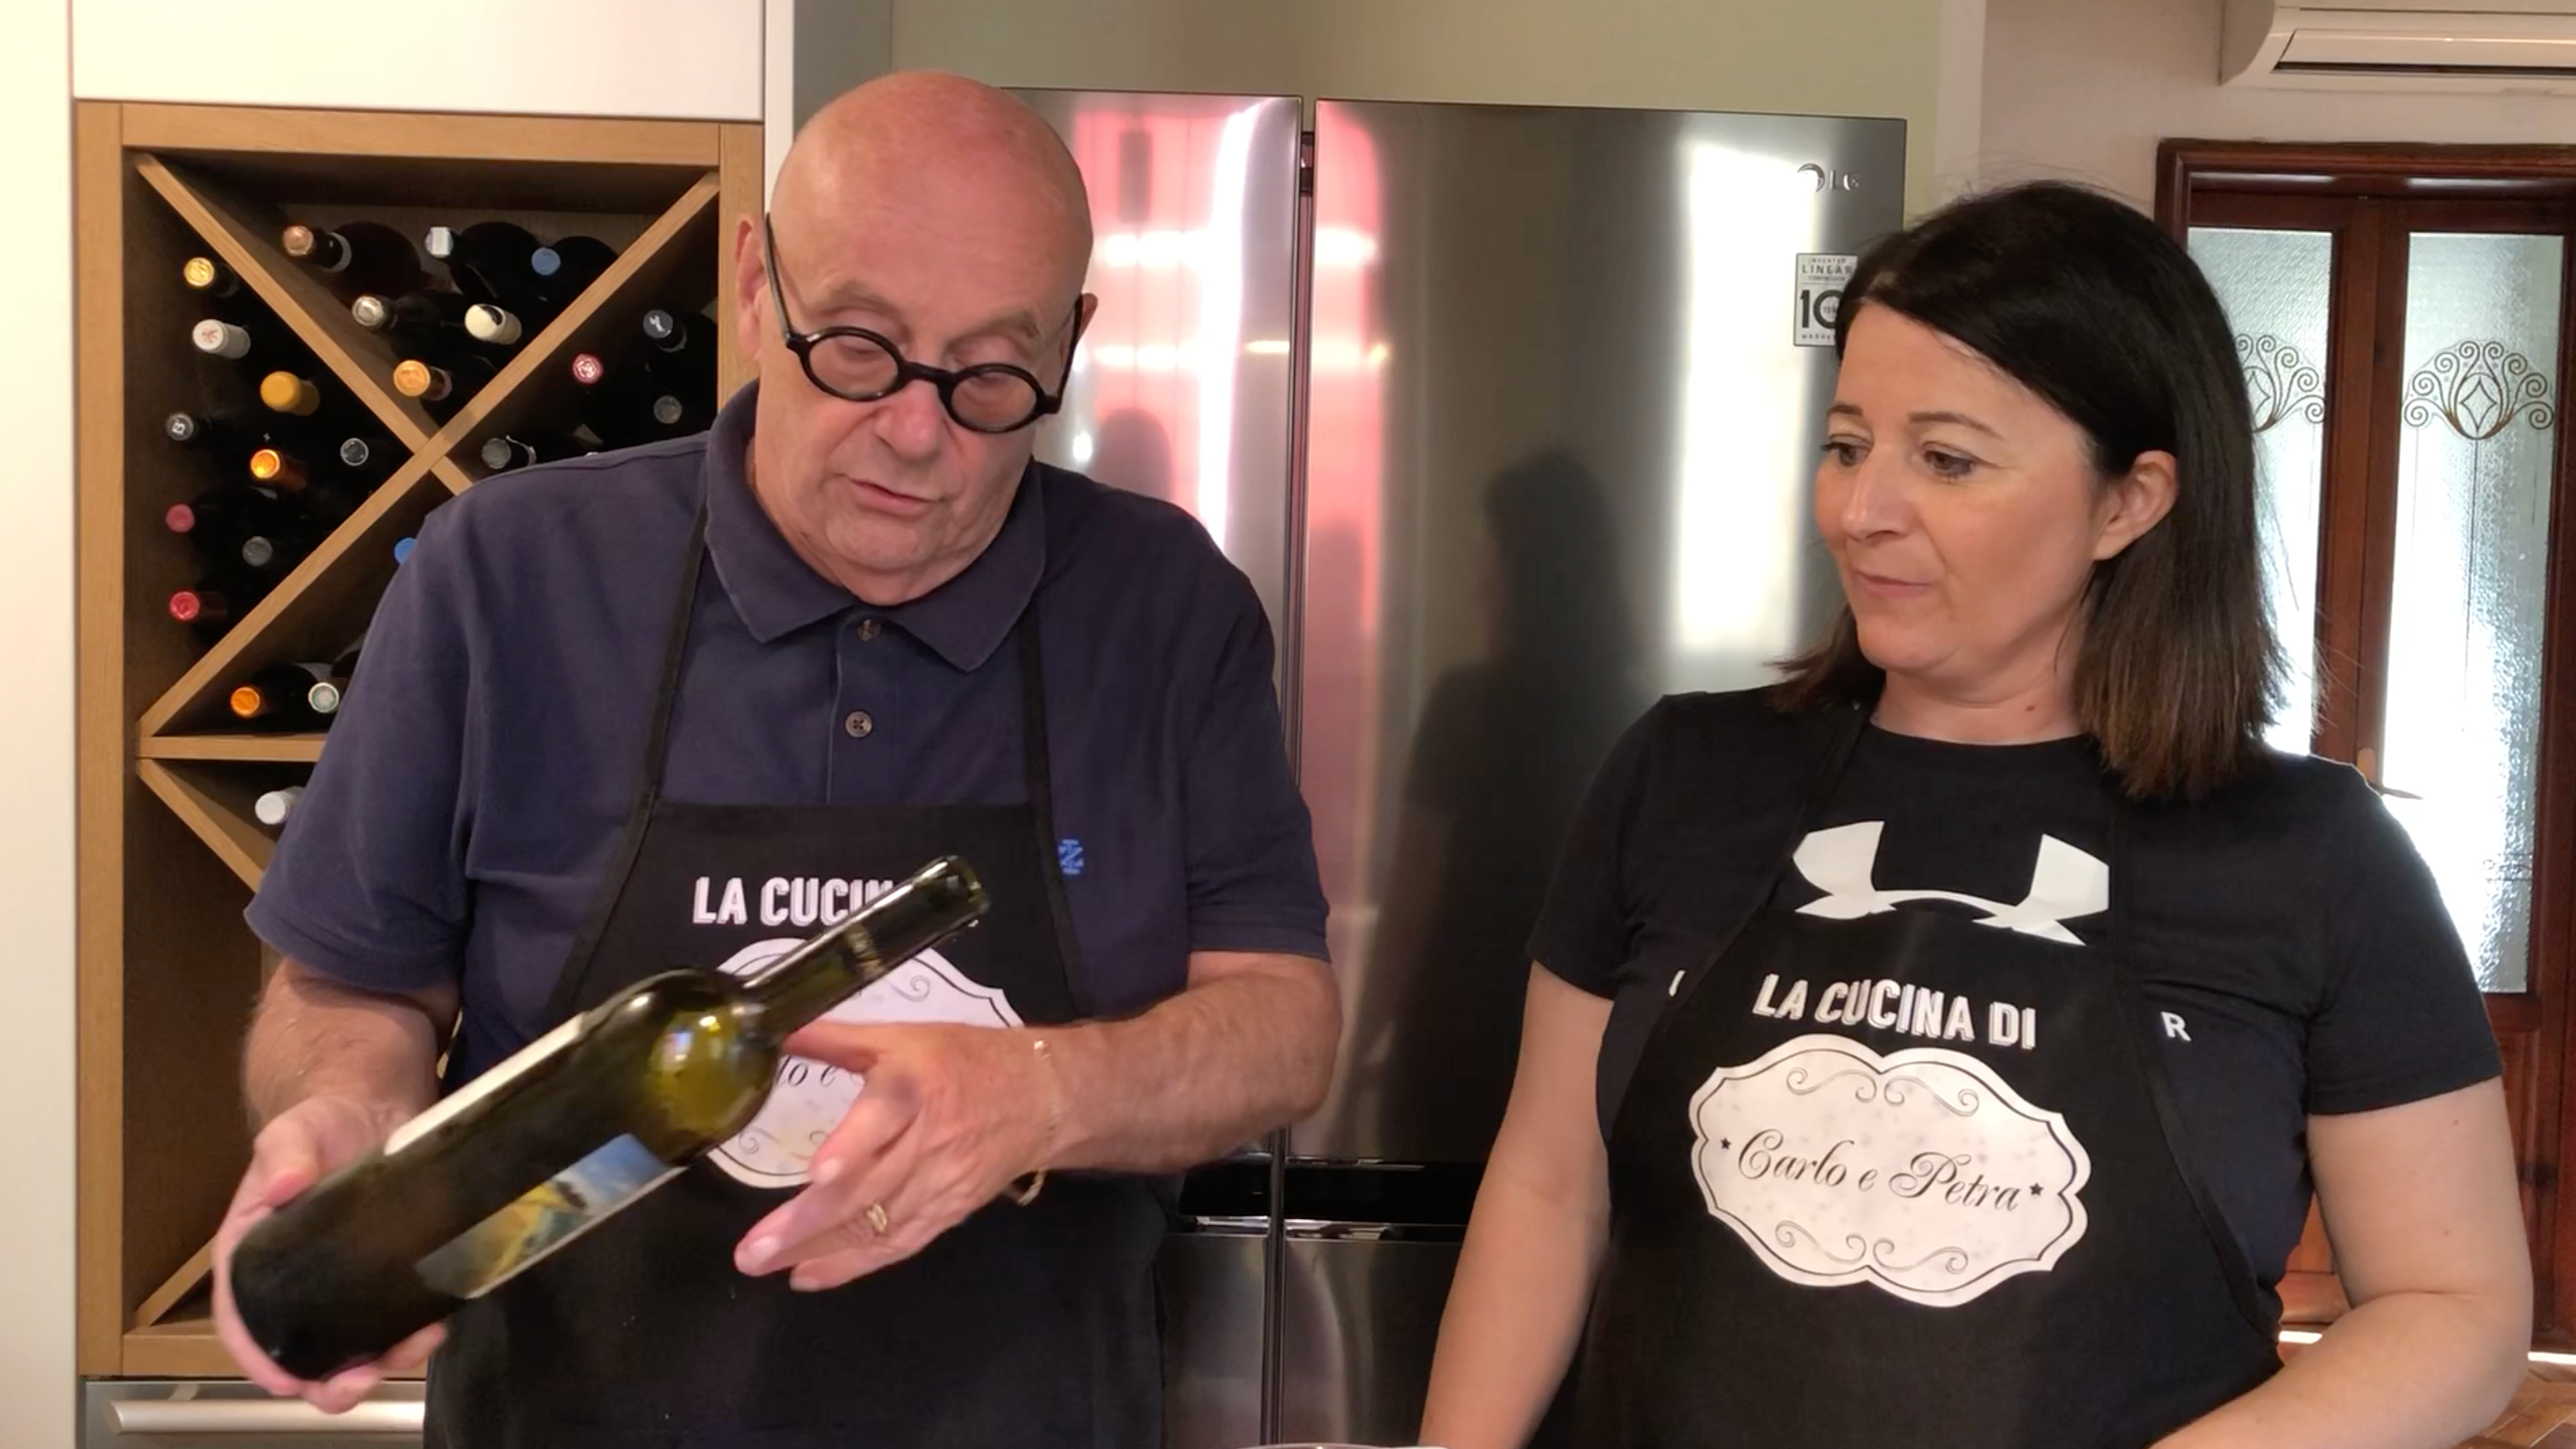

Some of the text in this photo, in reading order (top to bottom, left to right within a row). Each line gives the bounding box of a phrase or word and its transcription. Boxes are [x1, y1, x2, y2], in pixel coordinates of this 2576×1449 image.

[1802, 264, 1852, 274] LINEAR
[693, 876, 747, 925] LA
[1752, 973, 2036, 1049] LA CUCINA DI
[1737, 1128, 2022, 1212] Carlo e Petra
